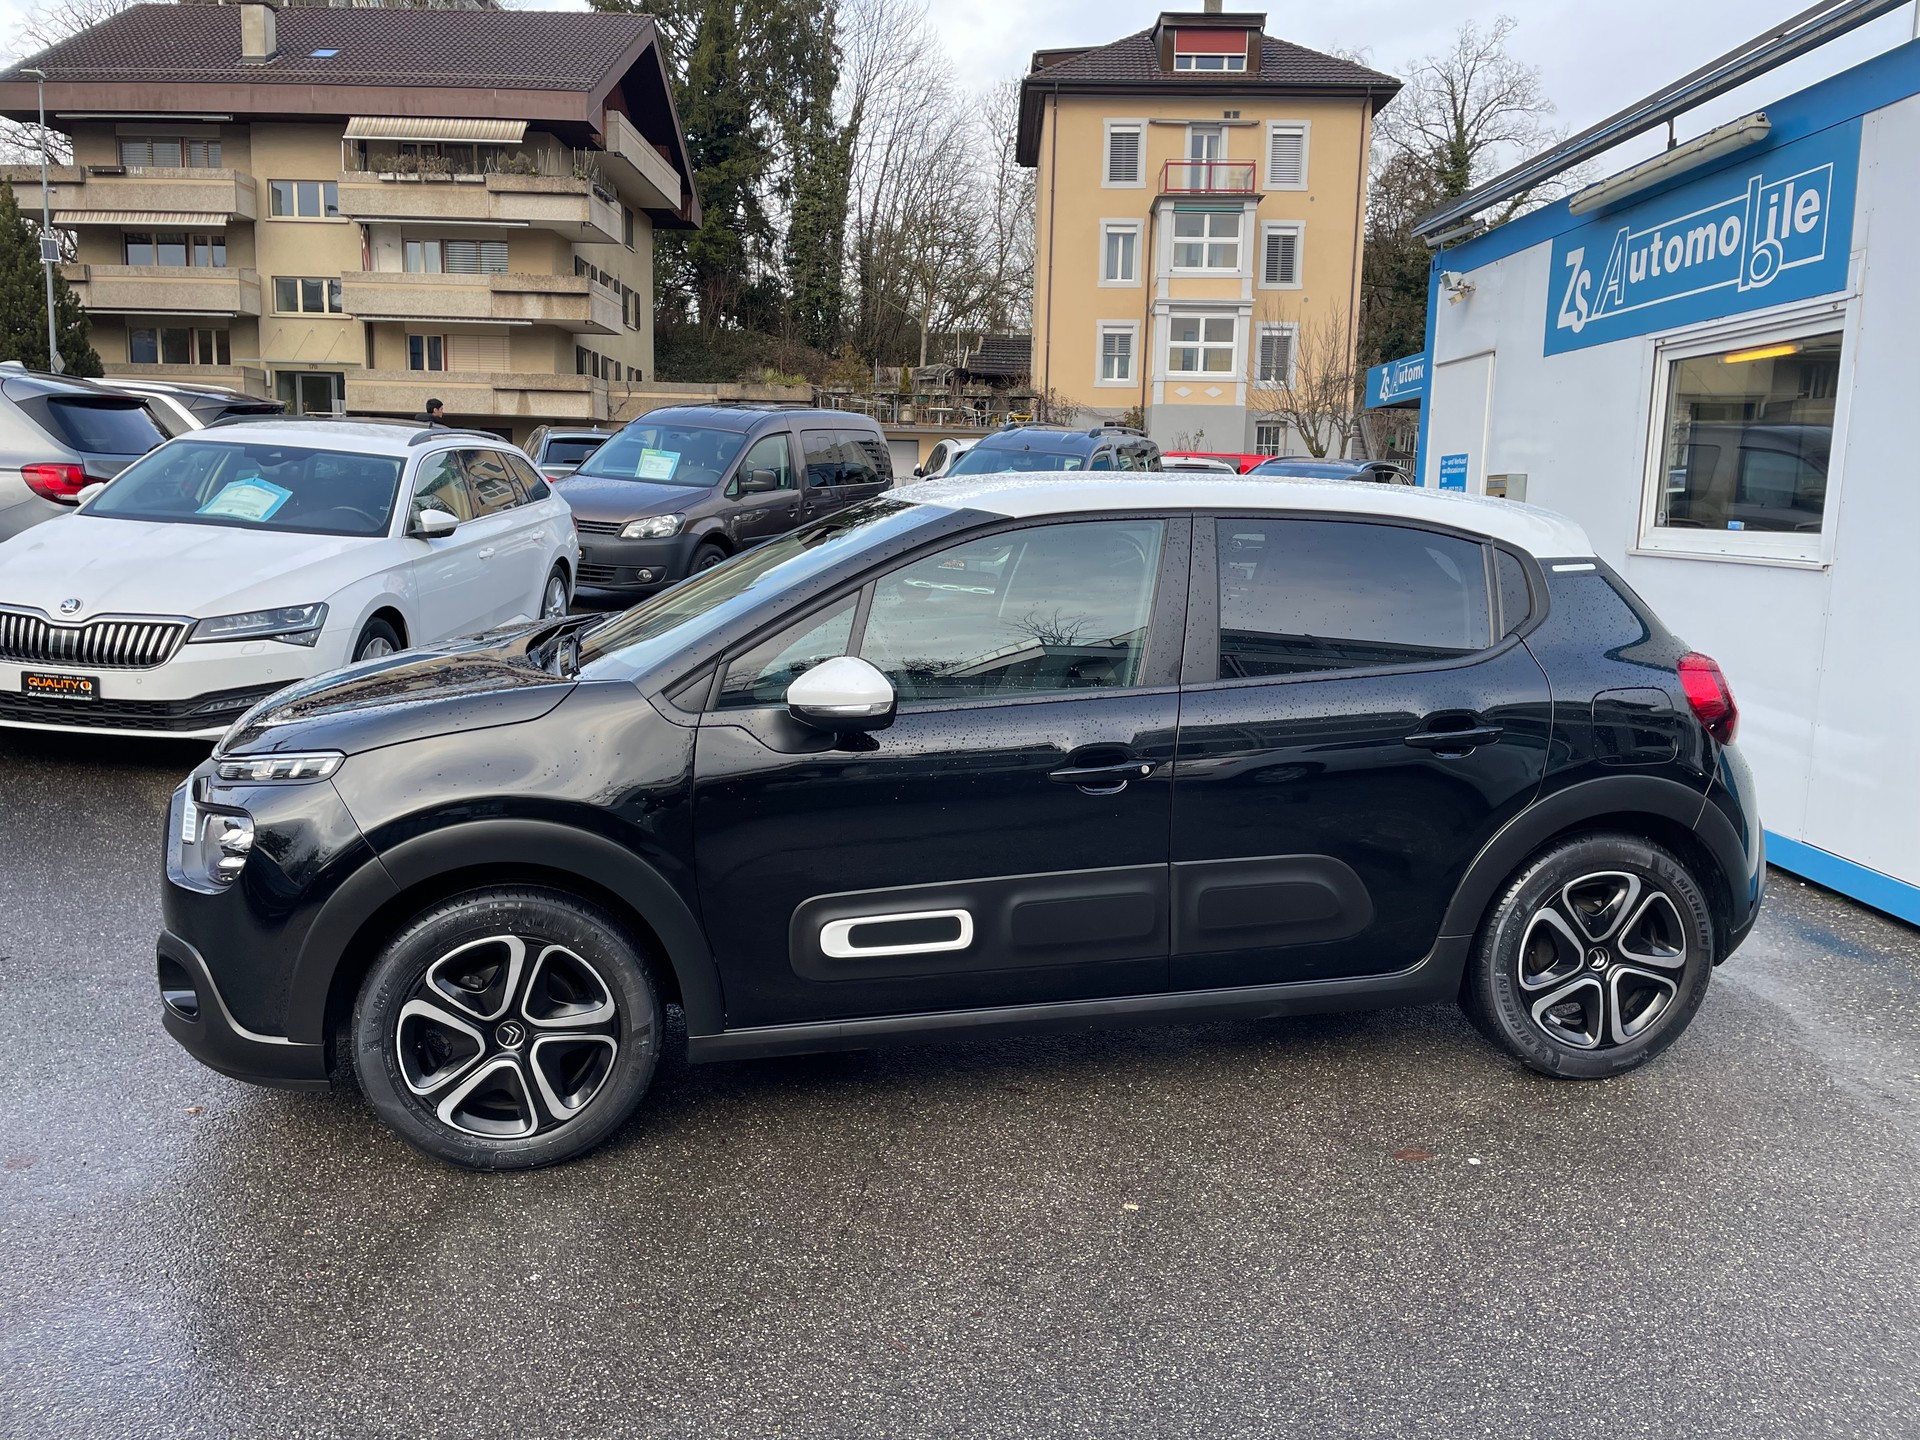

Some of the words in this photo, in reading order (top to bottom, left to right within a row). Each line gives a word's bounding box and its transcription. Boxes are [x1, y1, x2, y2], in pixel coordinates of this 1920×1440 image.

[1591, 175, 1820, 318] Automobile
[1676, 878, 1709, 945] MICHELIN
[1499, 978, 1535, 1046] MICHELIN
